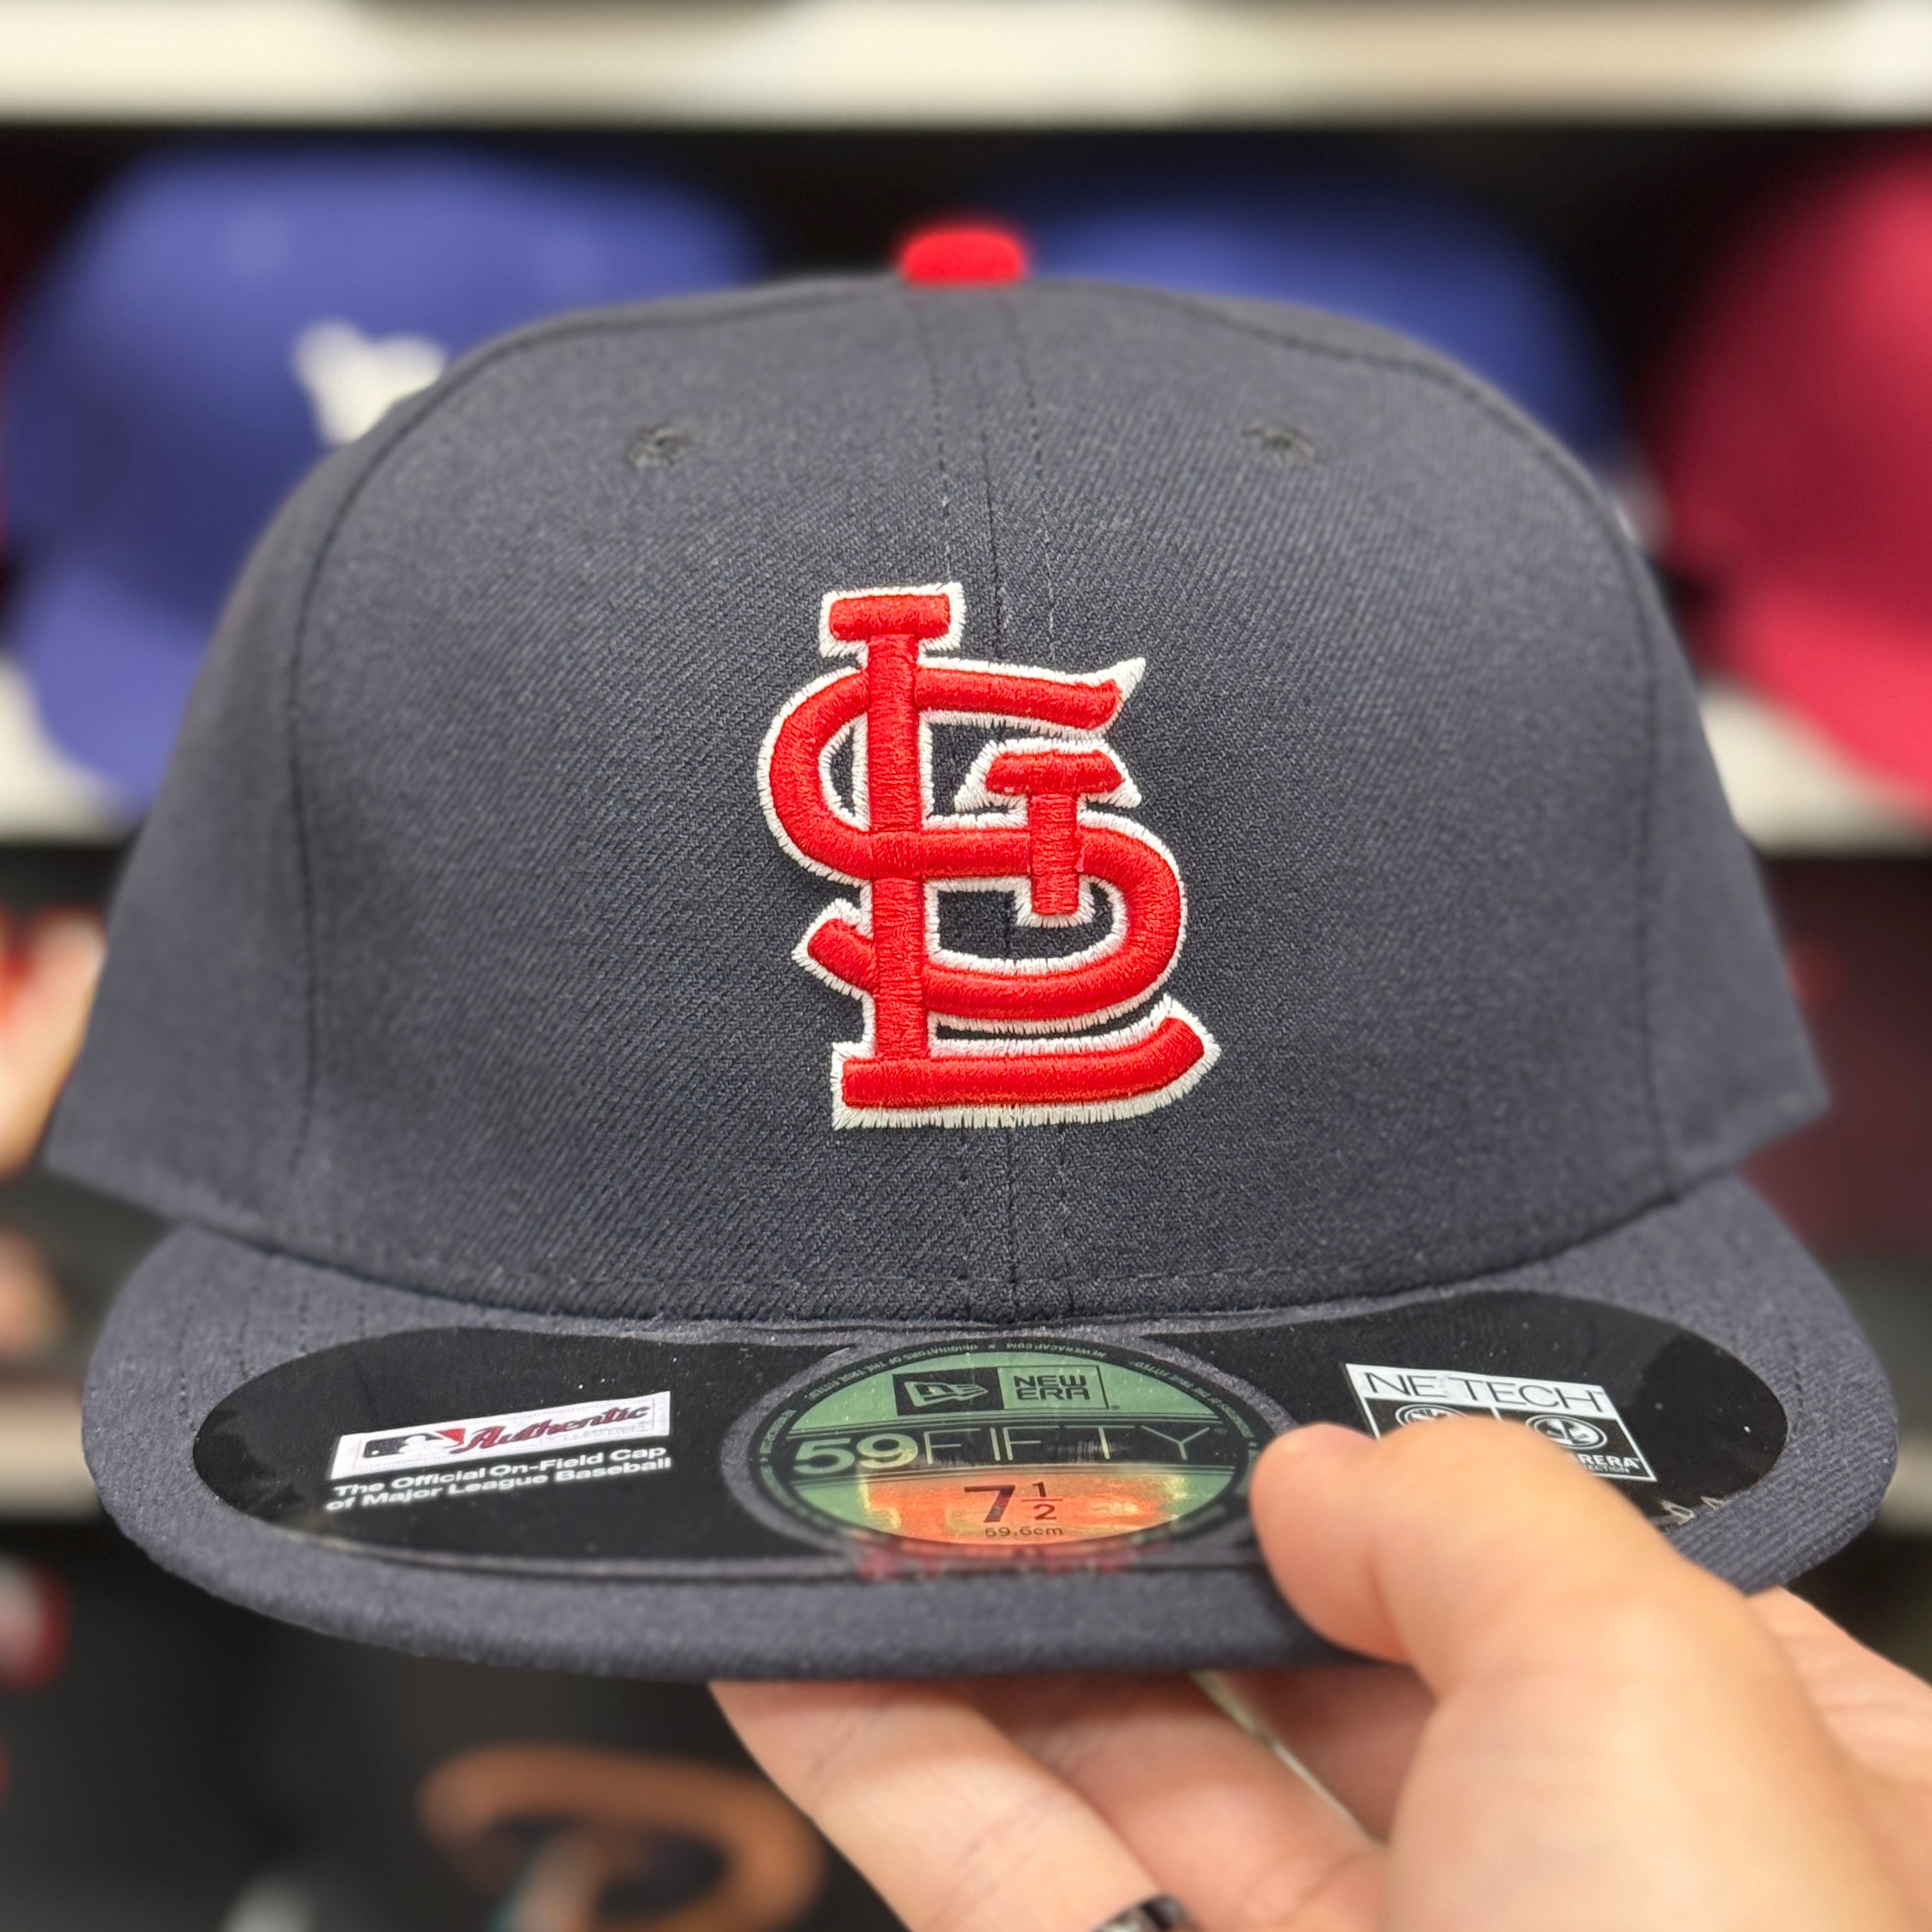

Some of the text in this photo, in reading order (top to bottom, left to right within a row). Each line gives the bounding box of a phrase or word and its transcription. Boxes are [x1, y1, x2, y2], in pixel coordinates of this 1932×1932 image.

[1014, 1375, 1087, 1387] NEW
[1017, 1387, 1090, 1400] ERA
[1364, 1372, 1447, 1397] NE
[449, 1406, 650, 1454] Authentic
[793, 1425, 1211, 1474] 59FIFTY
[326, 1457, 672, 1511] of Major League Baseball
[333, 1445, 667, 1497] The Official On-Field Cap
[964, 1484, 1016, 1523] 7
[985, 1526, 1064, 1537] 59.6cm
